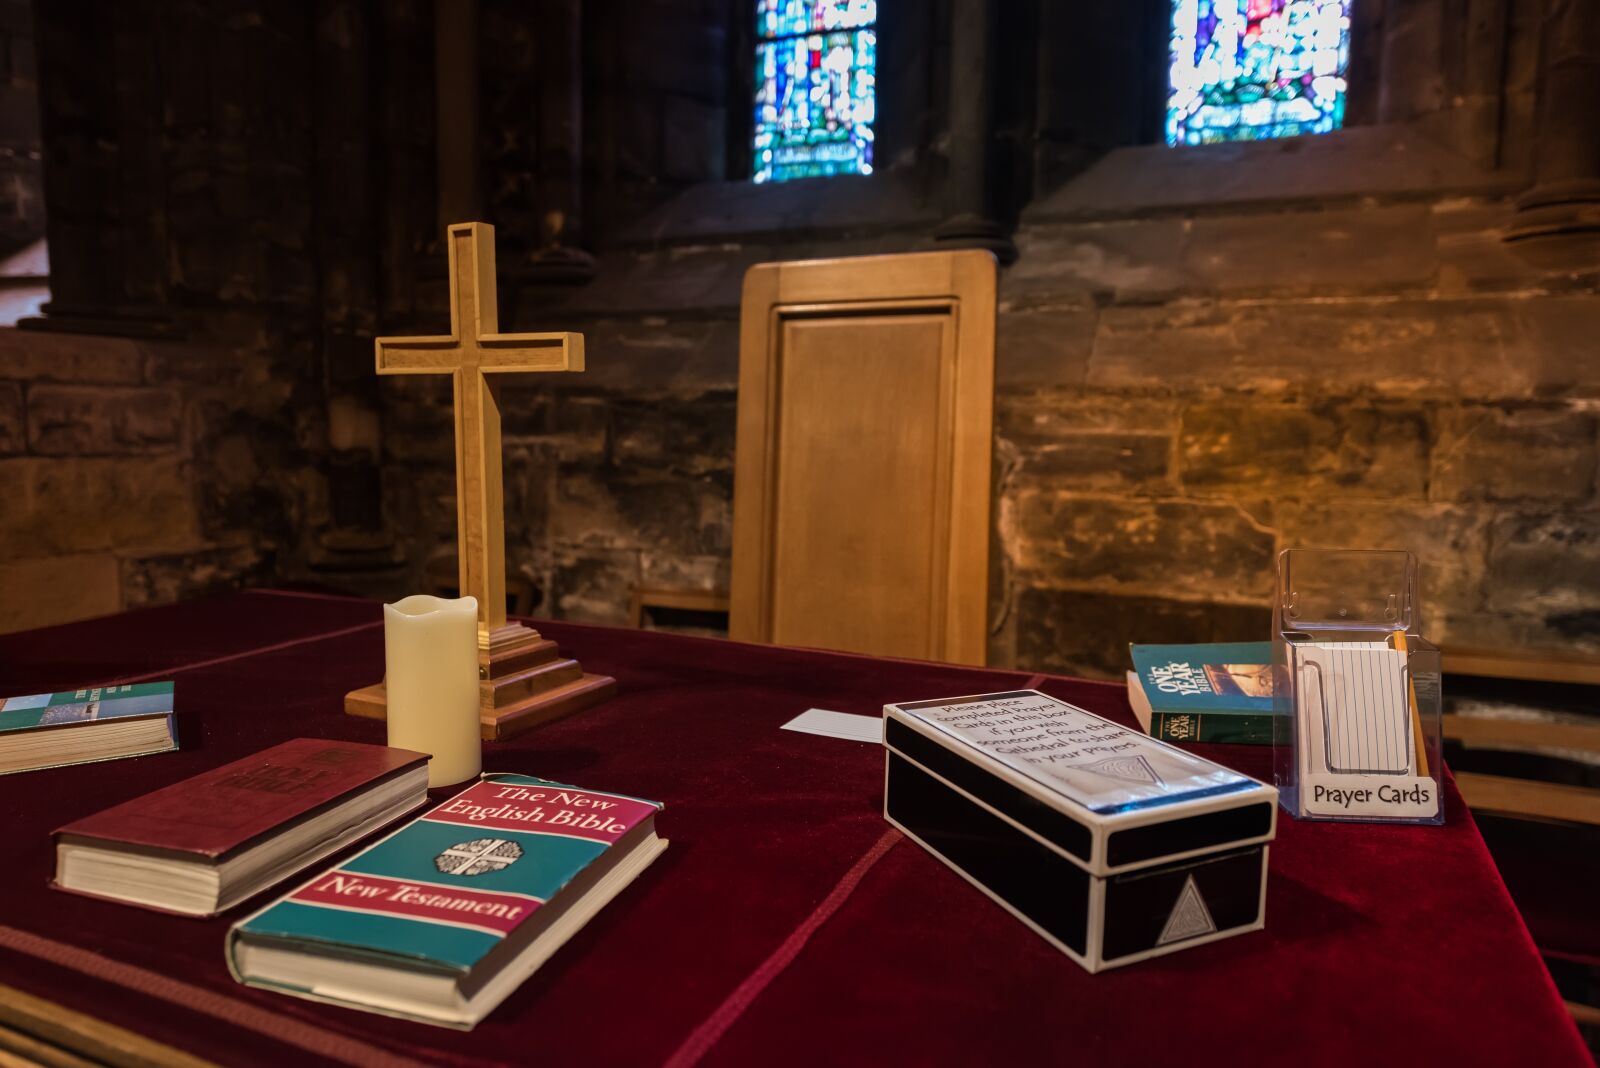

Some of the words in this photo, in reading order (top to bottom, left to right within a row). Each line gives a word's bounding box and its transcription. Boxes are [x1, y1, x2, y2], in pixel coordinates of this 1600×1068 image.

[1151, 666, 1178, 692] ONE
[1169, 662, 1200, 695] YEAR
[1192, 668, 1212, 692] BIBLE
[937, 709, 1012, 721] completed
[1011, 703, 1055, 713] Prayer
[941, 703, 987, 713] Please
[987, 700, 1024, 709] place
[953, 720, 996, 729] Cards
[1012, 714, 1041, 722] this
[1039, 710, 1071, 719] box
[1003, 725, 1035, 735] you
[1035, 720, 1069, 728] wish
[1170, 716, 1180, 737] ONE
[1178, 714, 1190, 740] YEAR
[976, 734, 1049, 745] someone
[1045, 728, 1087, 736] from
[1085, 722, 1114, 731] the
[995, 738, 1071, 754] Cathedral
[1089, 730, 1130, 742] share
[1042, 750, 1081, 762] your
[493, 786, 546, 802] The
[549, 791, 620, 811] New
[1314, 785, 1373, 808] Prayer
[1377, 783, 1430, 805] Cards
[440, 799, 546, 822] English
[545, 808, 627, 834] Bible
[315, 875, 389, 899] New
[385, 883, 525, 921] Testament
